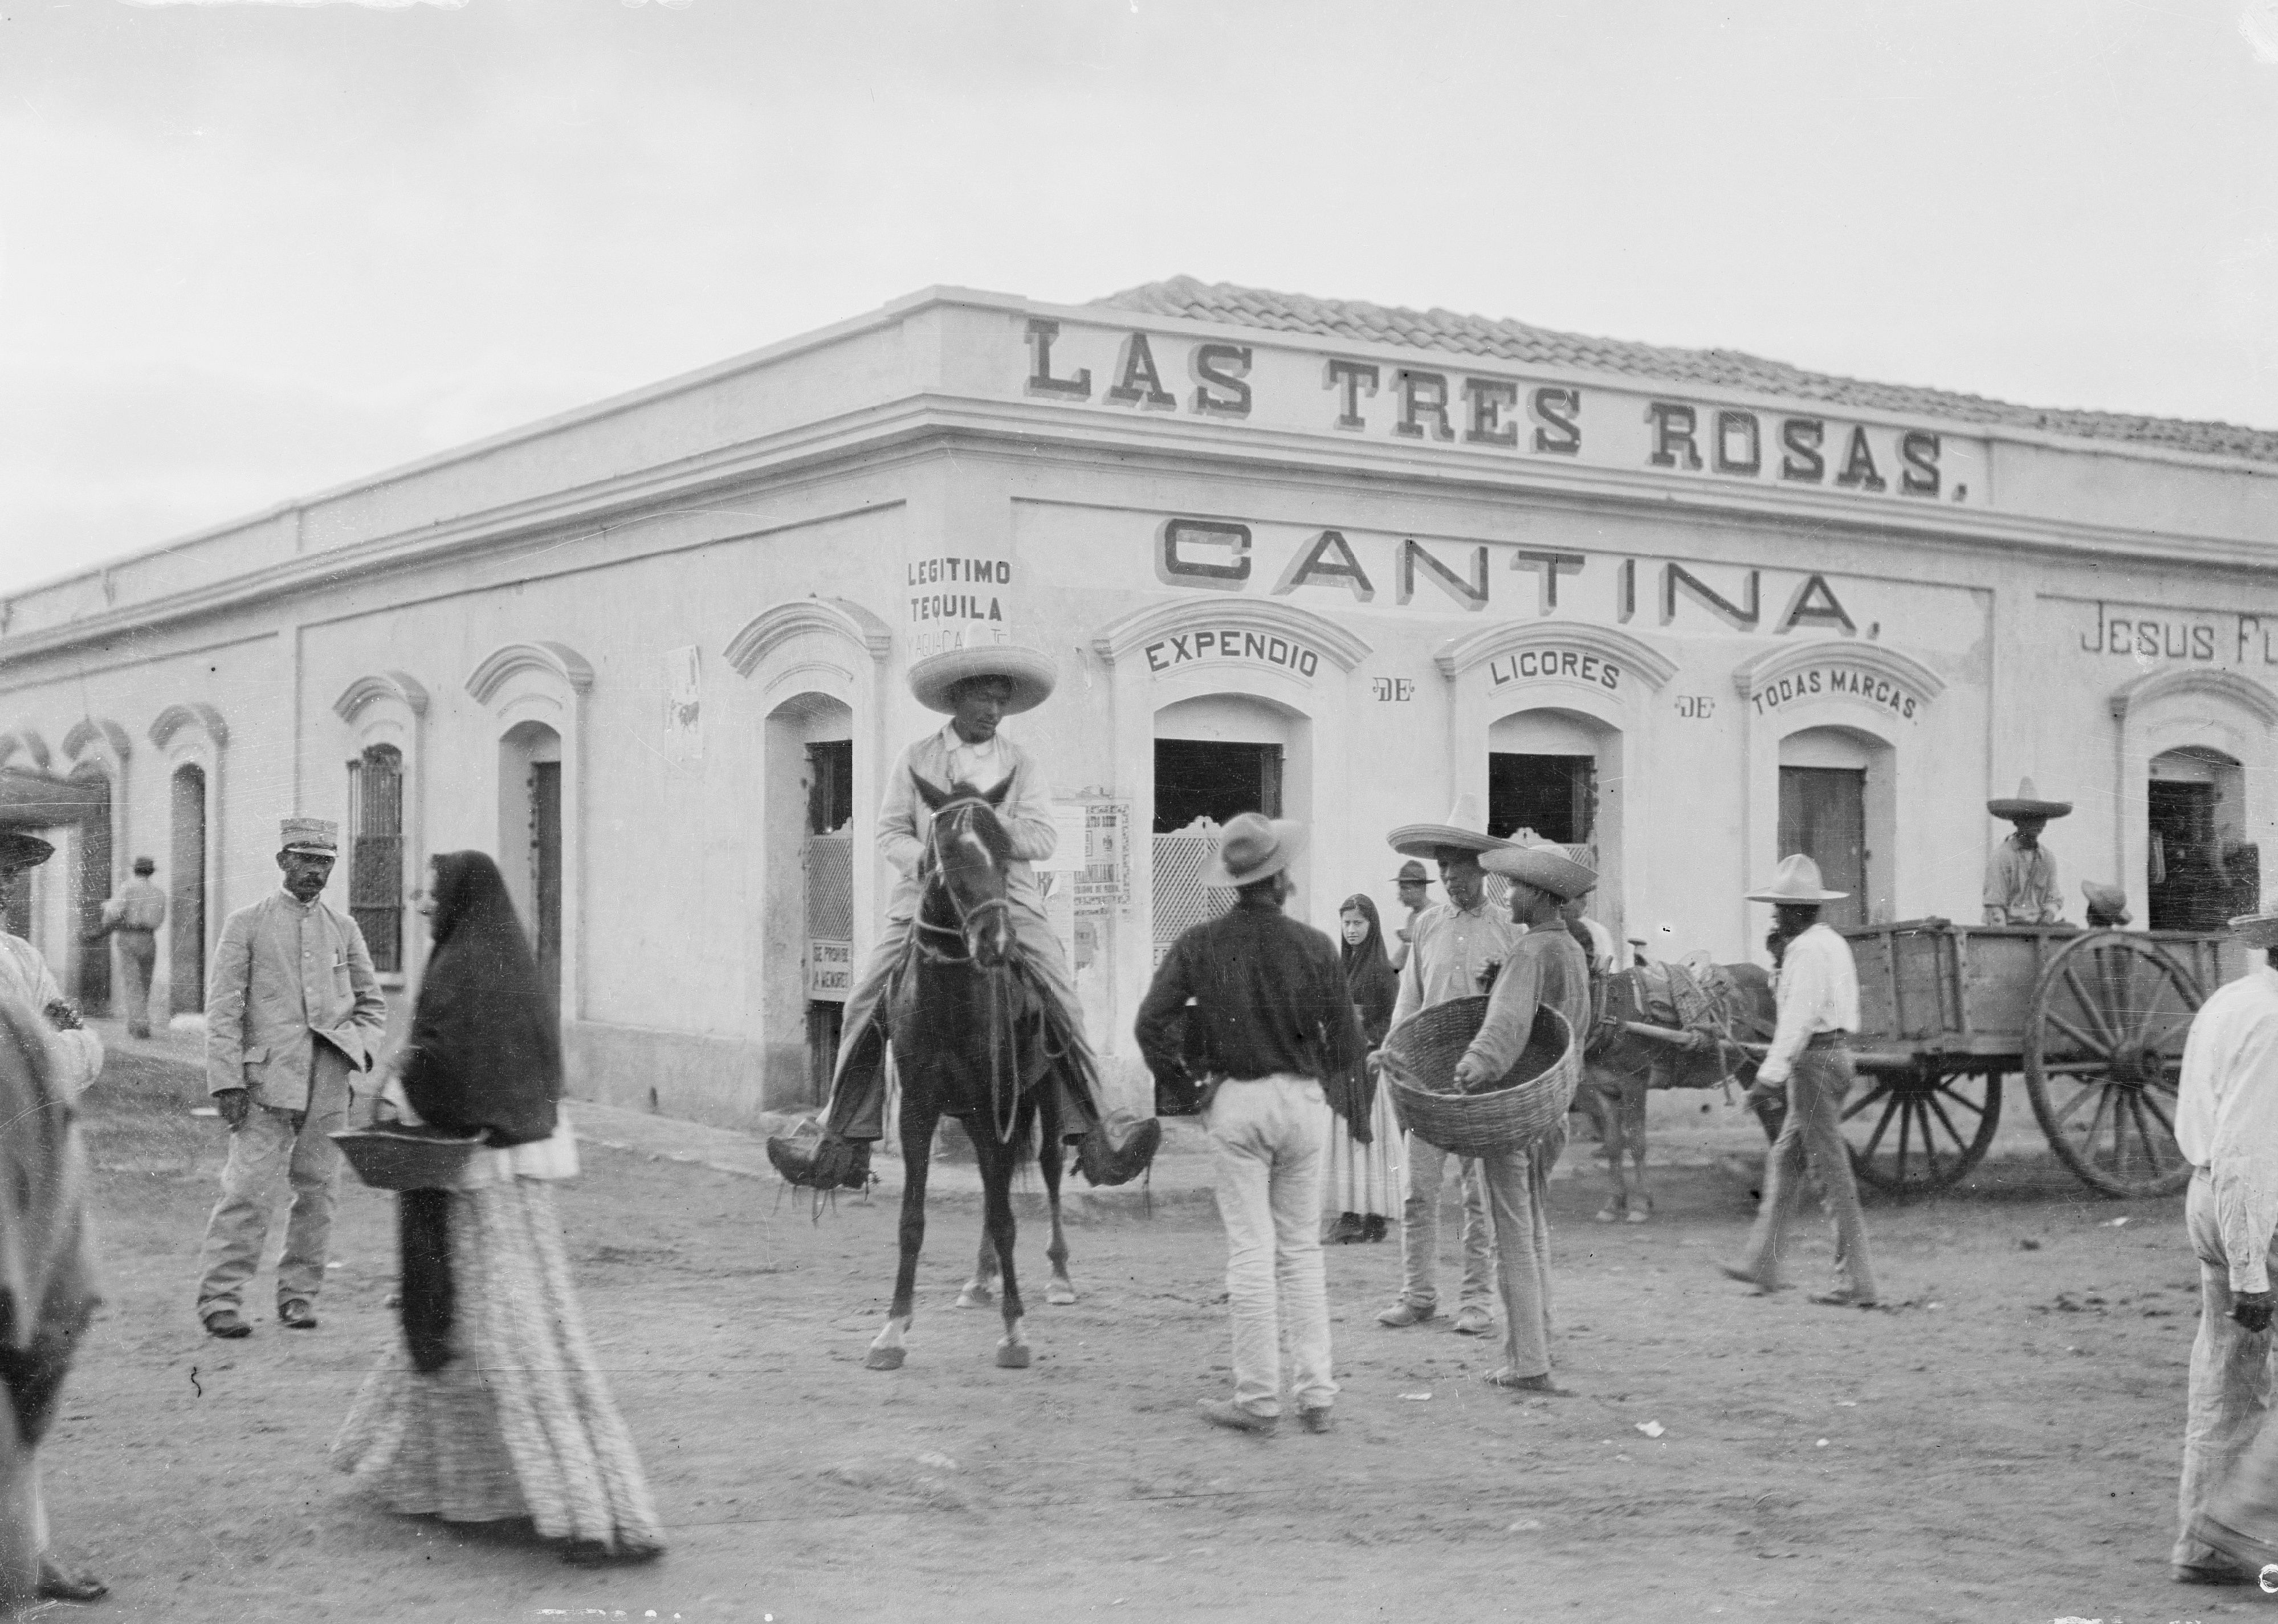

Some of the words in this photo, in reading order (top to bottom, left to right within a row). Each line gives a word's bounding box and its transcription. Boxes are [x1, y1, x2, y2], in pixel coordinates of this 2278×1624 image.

[1024, 319, 1252, 420] LAS
[1323, 358, 1581, 456] TRES
[1645, 401, 1968, 503] ROSAS.
[907, 557, 1010, 586] LEGITIMO
[1155, 518, 1880, 640] CANTINA.
[910, 594, 1003, 625] TEQUILA
[2082, 601, 2214, 661] JESUS
[1145, 631, 1319, 678] EXPENDIO
[1490, 651, 1621, 691] LICORES
[1372, 677, 1415, 701] DE
[1674, 695, 1715, 719] DE
[1752, 670, 1821, 716] TODAS
